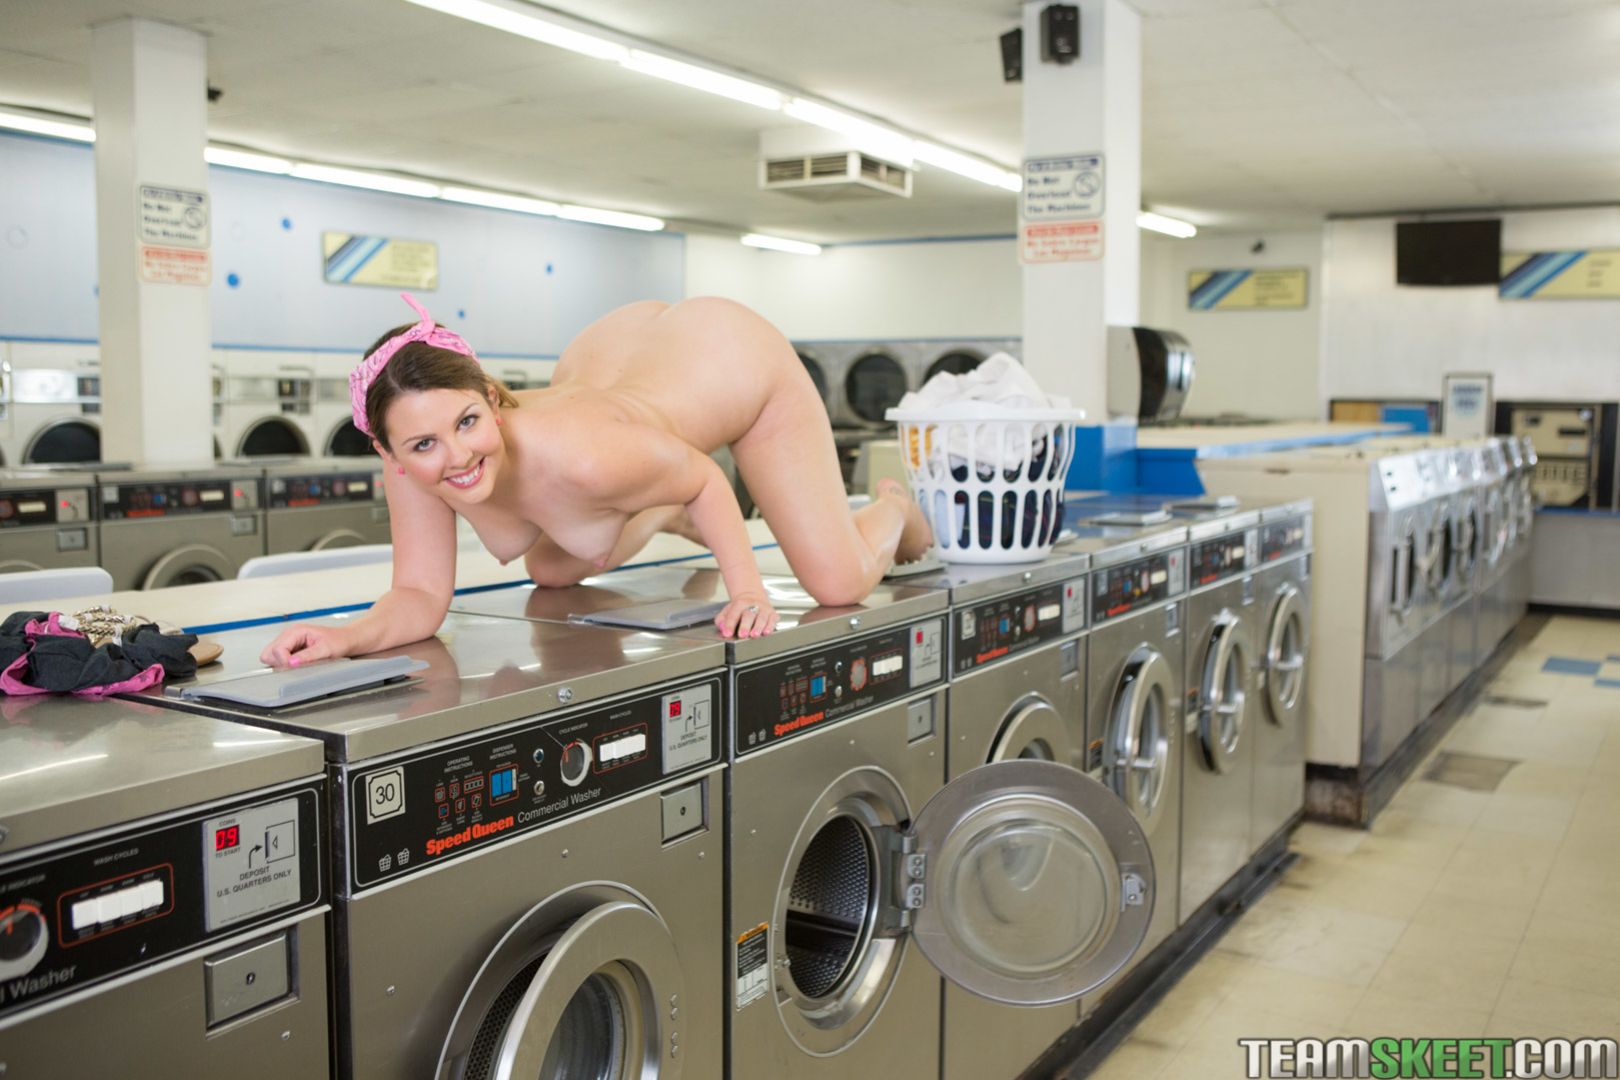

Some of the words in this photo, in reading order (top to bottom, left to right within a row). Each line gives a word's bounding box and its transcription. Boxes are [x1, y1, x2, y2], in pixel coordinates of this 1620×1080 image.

[447, 755, 470, 766] OPERATING
[376, 783, 396, 805] 30
[518, 795, 569, 825] Commercial
[570, 787, 601, 807] Washer
[216, 827, 238, 851] 09
[426, 827, 471, 856] Speed
[472, 815, 514, 840] Queen
[94, 854, 114, 866] WASH
[115, 848, 140, 861] CYCLES
[217, 888, 231, 898] U.S.
[233, 875, 272, 893] QUARTERS
[274, 869, 292, 880] ONLY
[240, 866, 270, 881] DEPOSIT
[9, 964, 78, 999] Washer
